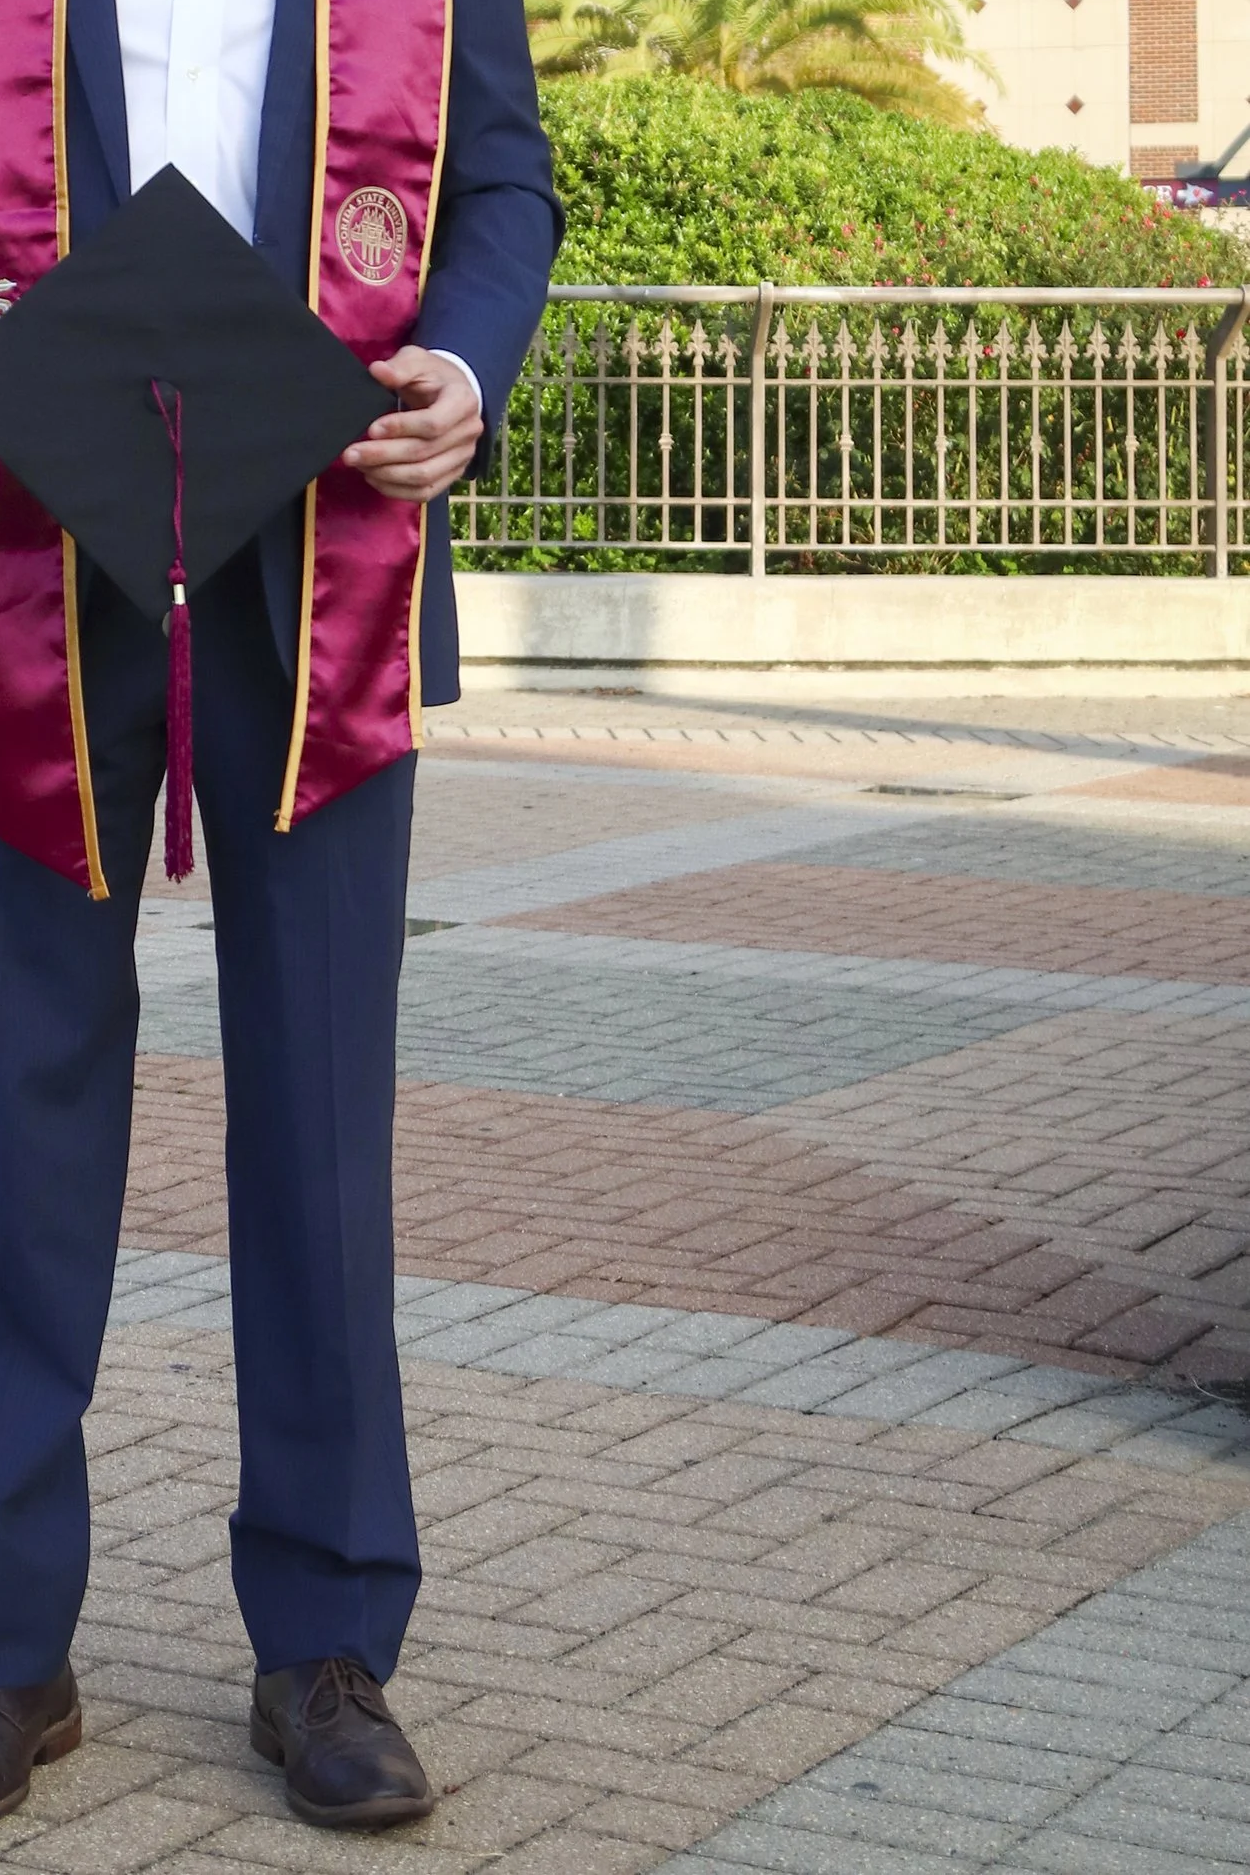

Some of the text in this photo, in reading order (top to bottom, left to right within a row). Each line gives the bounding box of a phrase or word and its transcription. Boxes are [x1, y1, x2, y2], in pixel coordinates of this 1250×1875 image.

[340, 193, 403, 266] FLORIDA STATE UNIVERSITY
[363, 268, 380, 279] 1851
